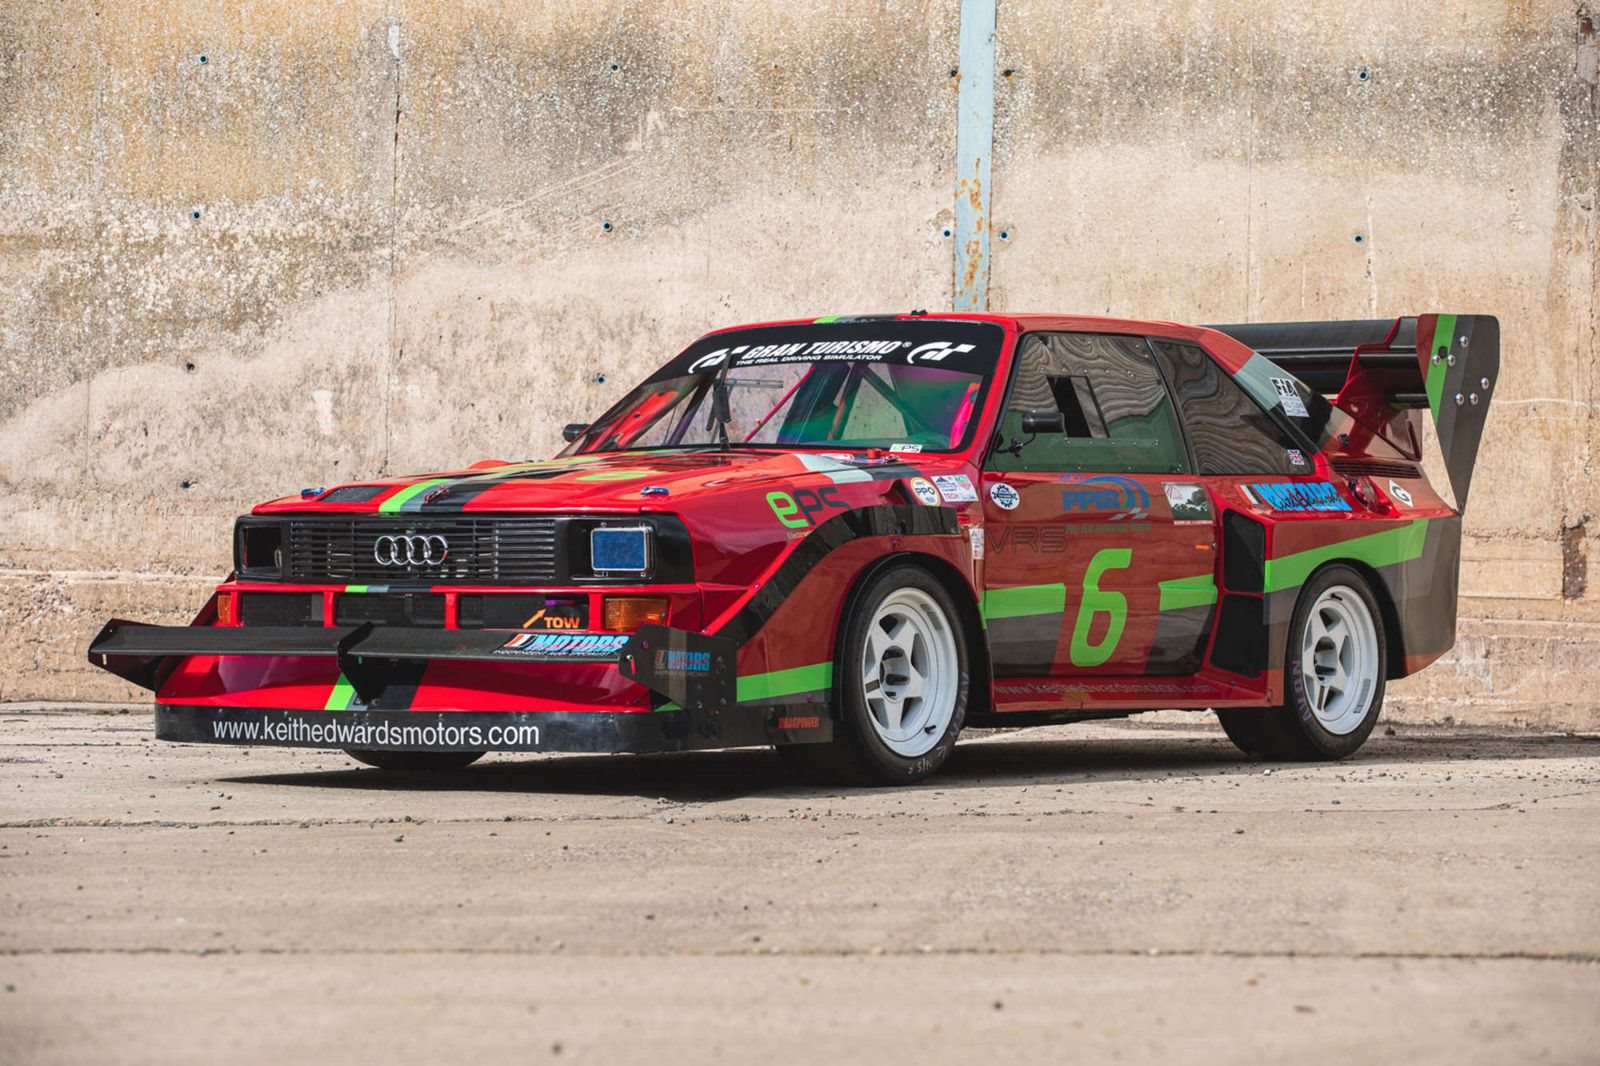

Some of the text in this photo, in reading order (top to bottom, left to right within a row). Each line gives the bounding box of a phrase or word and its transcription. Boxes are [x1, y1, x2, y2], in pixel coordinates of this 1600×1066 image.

[741, 341, 903, 360] GRAN TURISMO
[915, 487, 935, 496] PPO
[1063, 490, 1121, 512] PPIR
[986, 526, 1067, 554] VRS
[1070, 548, 1132, 667] 6
[544, 616, 580, 629] TOW
[213, 717, 539, 746] www.keithedwardsmotors.com
